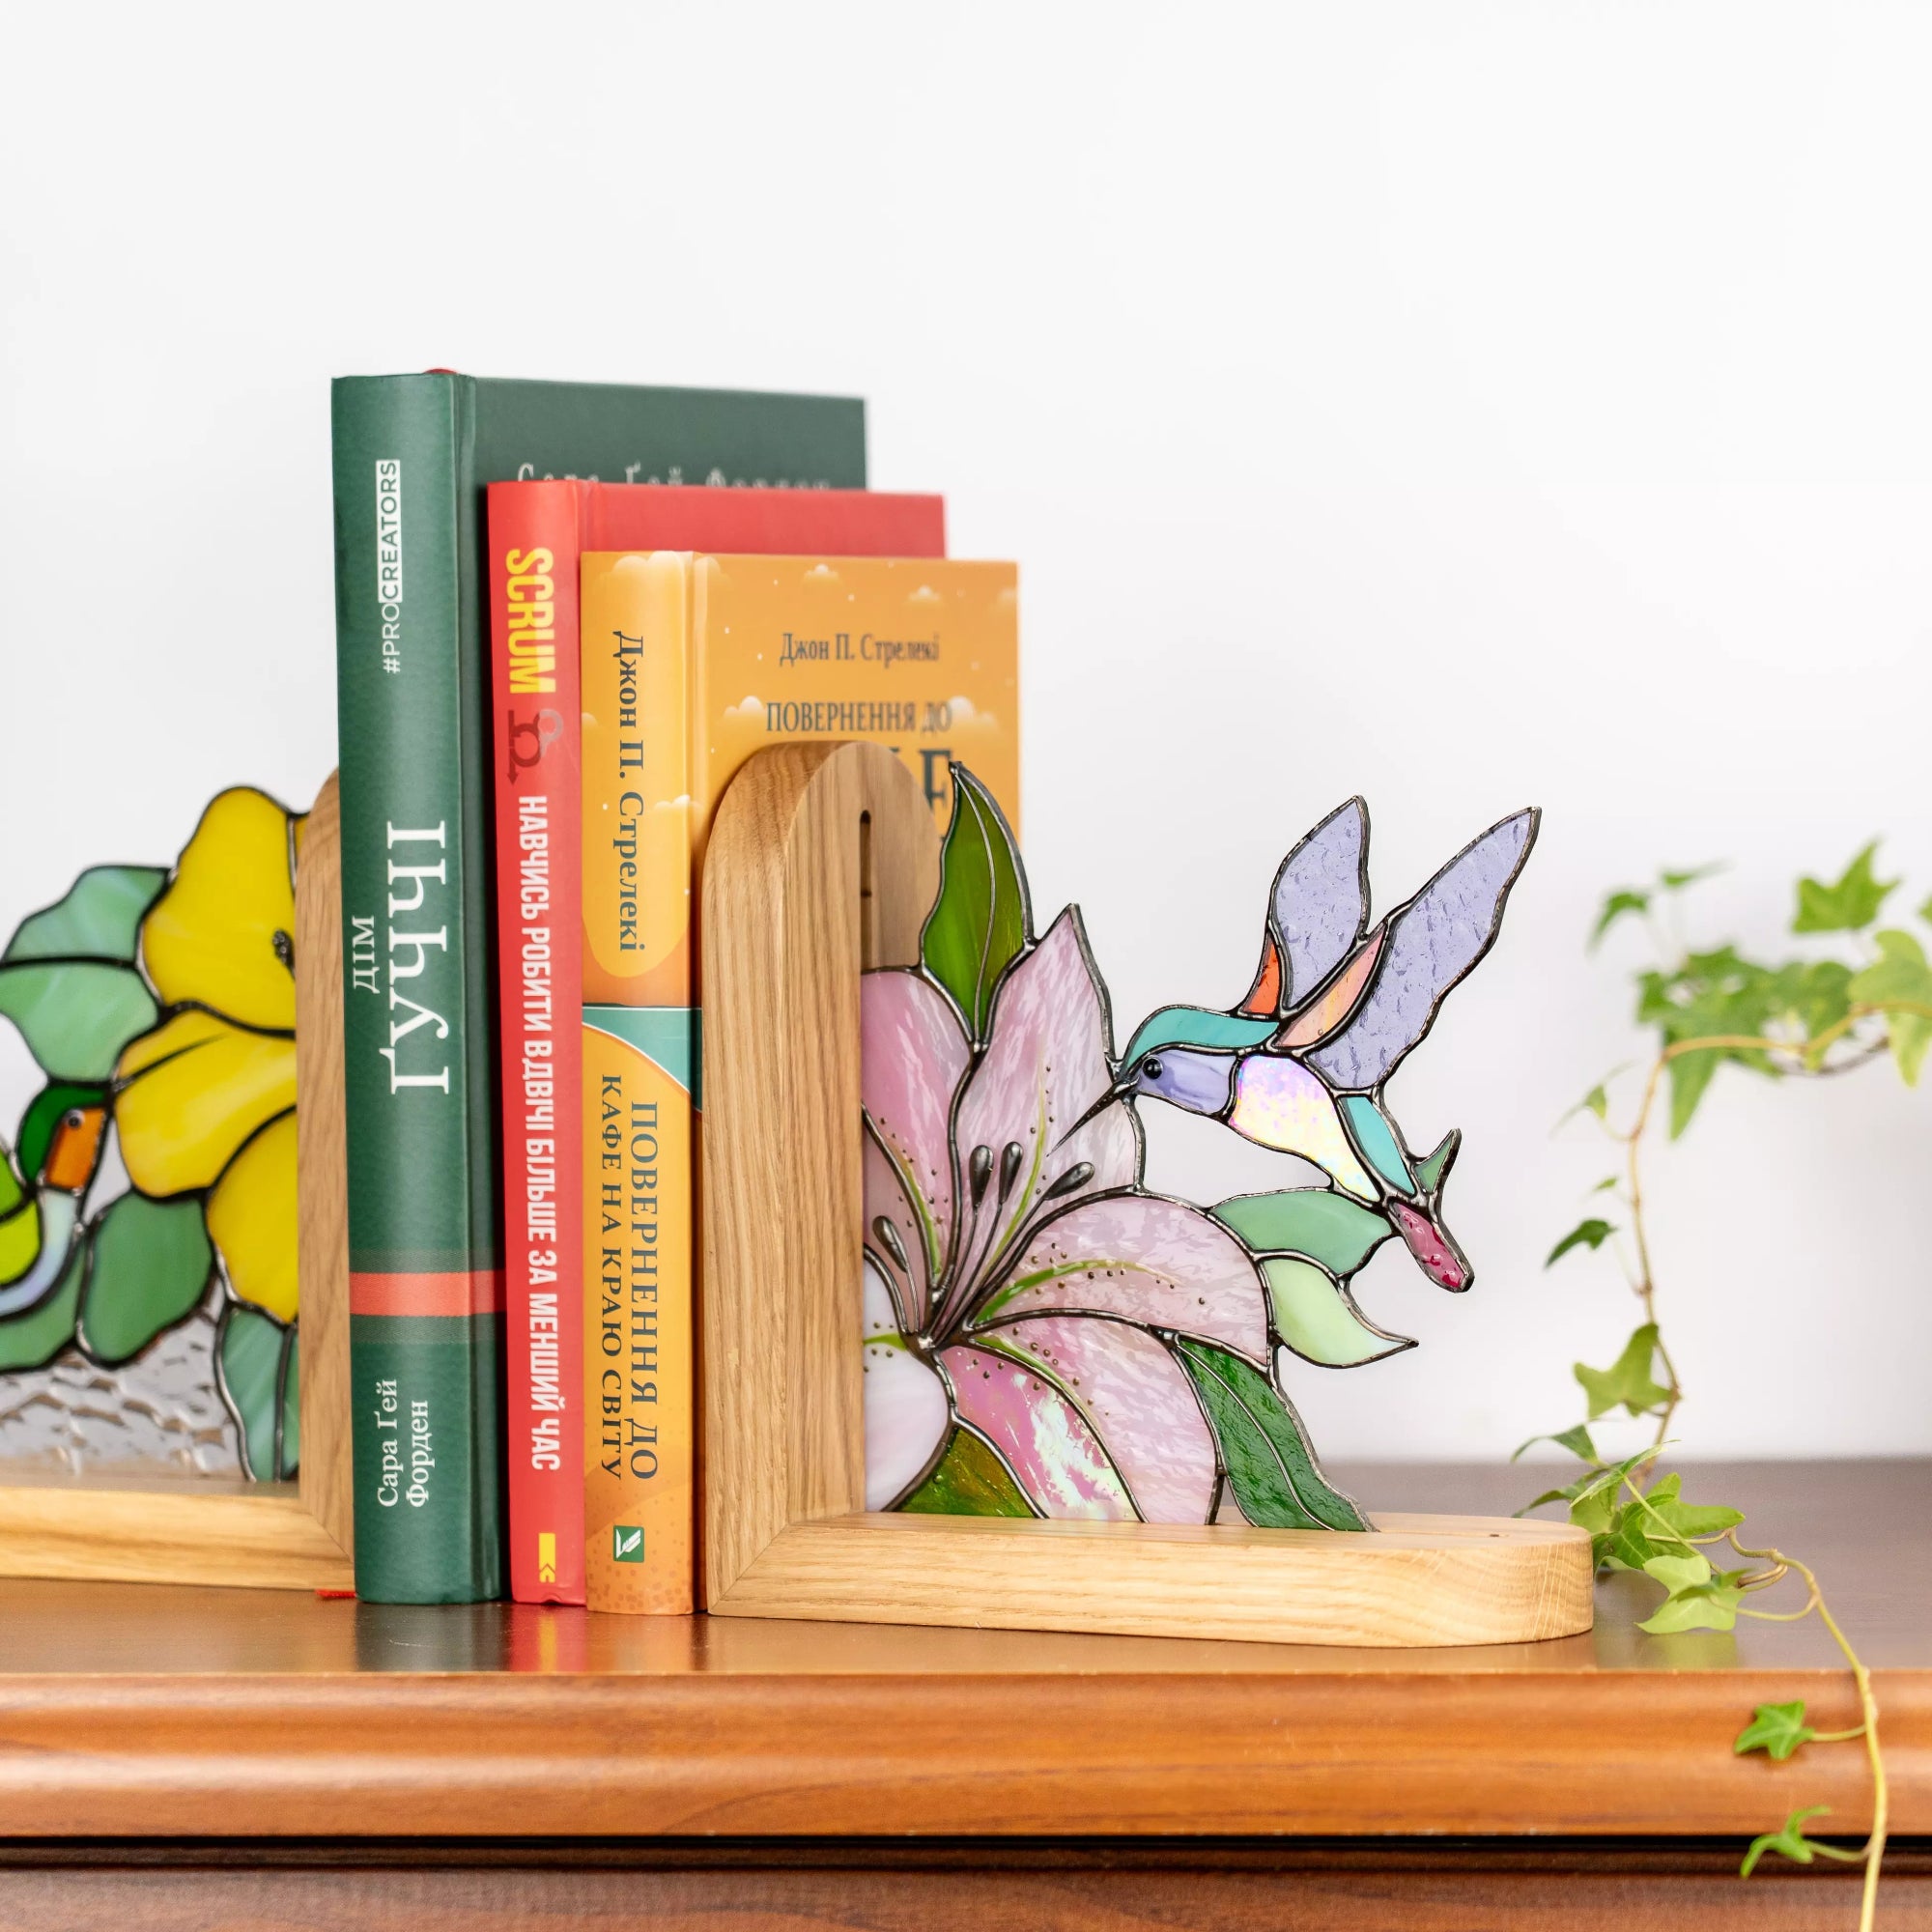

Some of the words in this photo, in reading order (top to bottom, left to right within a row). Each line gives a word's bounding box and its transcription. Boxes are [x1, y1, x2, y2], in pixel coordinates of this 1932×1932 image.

[378, 461, 402, 674] #PROCREATORS
[505, 547, 556, 694] SCRUM
[779, 633, 830, 667] Джон
[836, 633, 855, 661] П.
[612, 630, 644, 728] Джон
[765, 701, 916, 732] ПОВЕРНЕННЯ
[922, 701, 952, 737] ДО
[619, 740, 644, 780] П.
[518, 795, 550, 921] НАВЧИСЬ
[612, 791, 645, 952] Стрелекі
[352, 915, 380, 994] ДІМ
[379, 820, 449, 1095] ҐУЧЧІ
[522, 927, 553, 1031] РОБИТИ
[523, 1040, 554, 1130] ВДВІЧІ
[602, 1074, 622, 1171] КАФЕ
[526, 1139, 557, 1242] БІЛЬШЕ
[602, 1182, 622, 1236] НА
[527, 1251, 557, 1285] ЗА
[602, 1246, 622, 1357] КРАЮ
[631, 1100, 659, 1405] ПОВЕРНЕННЯ
[528, 1293, 565, 1411] МЕНШИЙ
[374, 1378, 398, 1431] Ґей
[530, 1419, 560, 1471] ЧАС
[601, 1369, 622, 1480] СВІТУ
[625, 1418, 659, 1480] ДО
[377, 1439, 404, 1508] Сара
[405, 1400, 436, 1508] Форден
